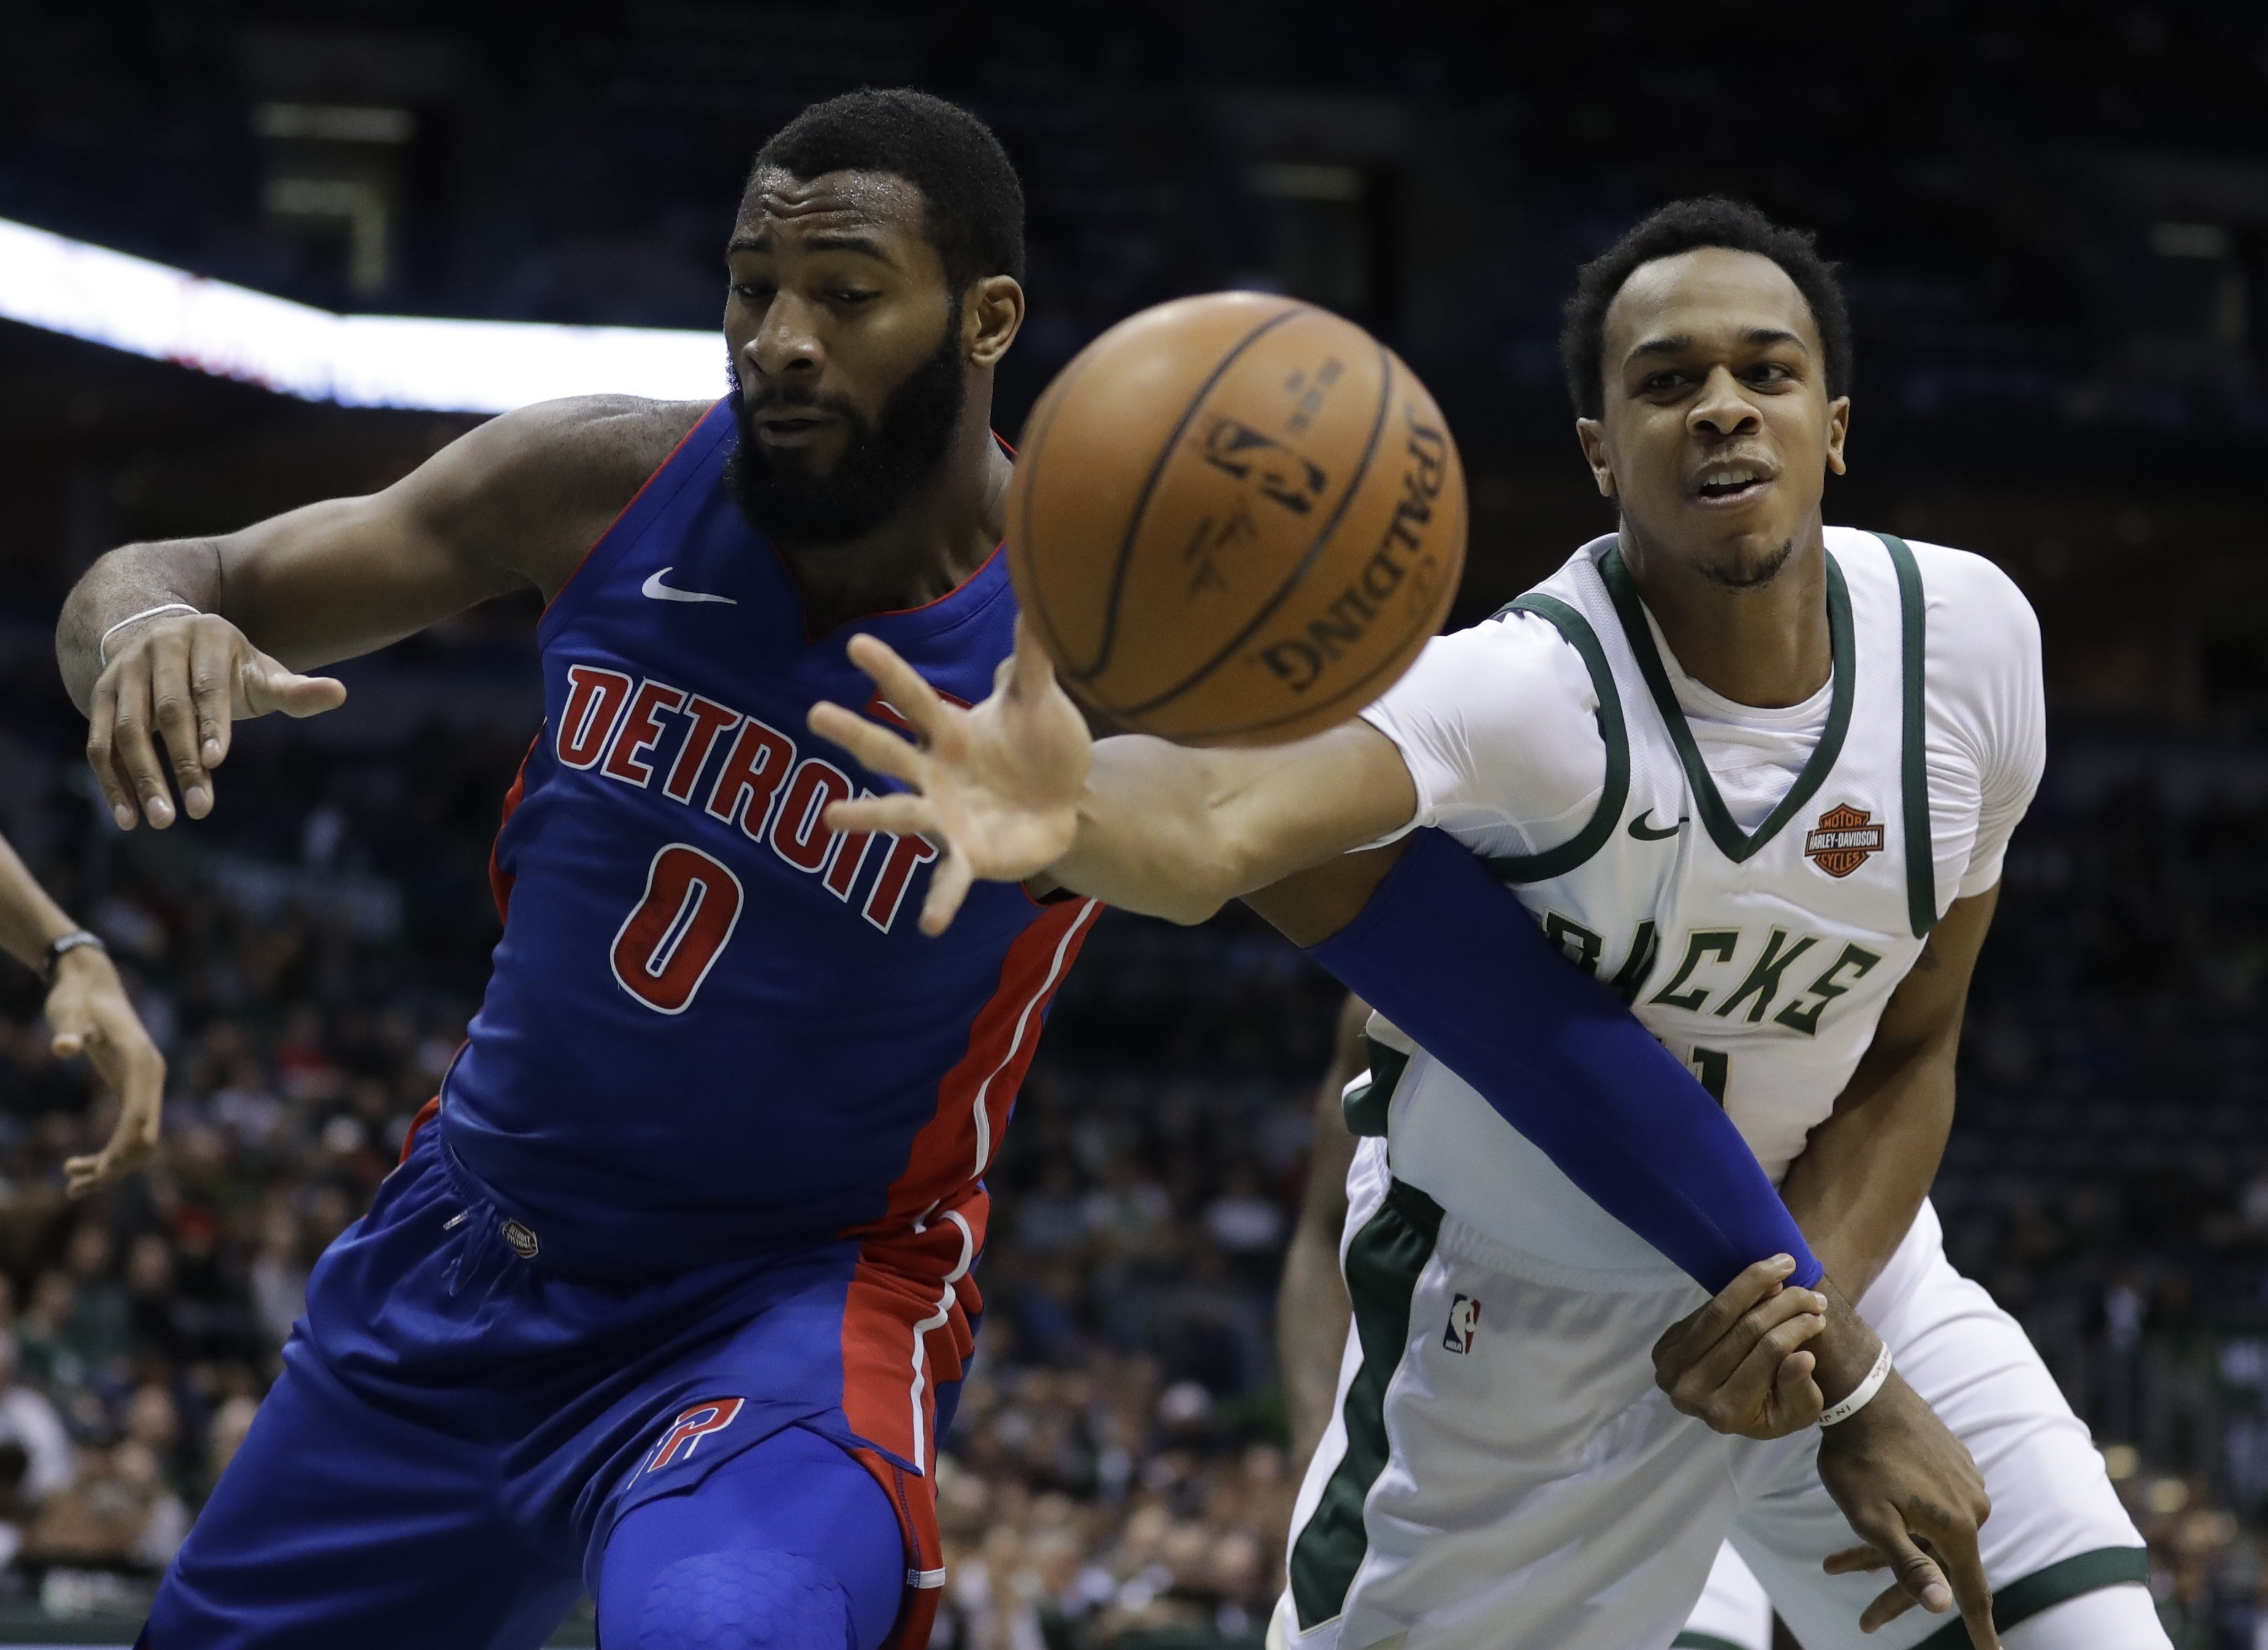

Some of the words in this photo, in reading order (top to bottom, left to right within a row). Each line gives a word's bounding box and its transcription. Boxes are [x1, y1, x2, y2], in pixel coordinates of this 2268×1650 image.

[1260, 405, 1448, 693] SPALDING
[556, 664, 939, 934] DETROIT
[1809, 830, 1878, 850] HARLEY-DAVIDSON
[1824, 810, 1862, 827] MOTOR
[1821, 851, 1860, 871] CYCLES
[610, 843, 744, 1015] 0
